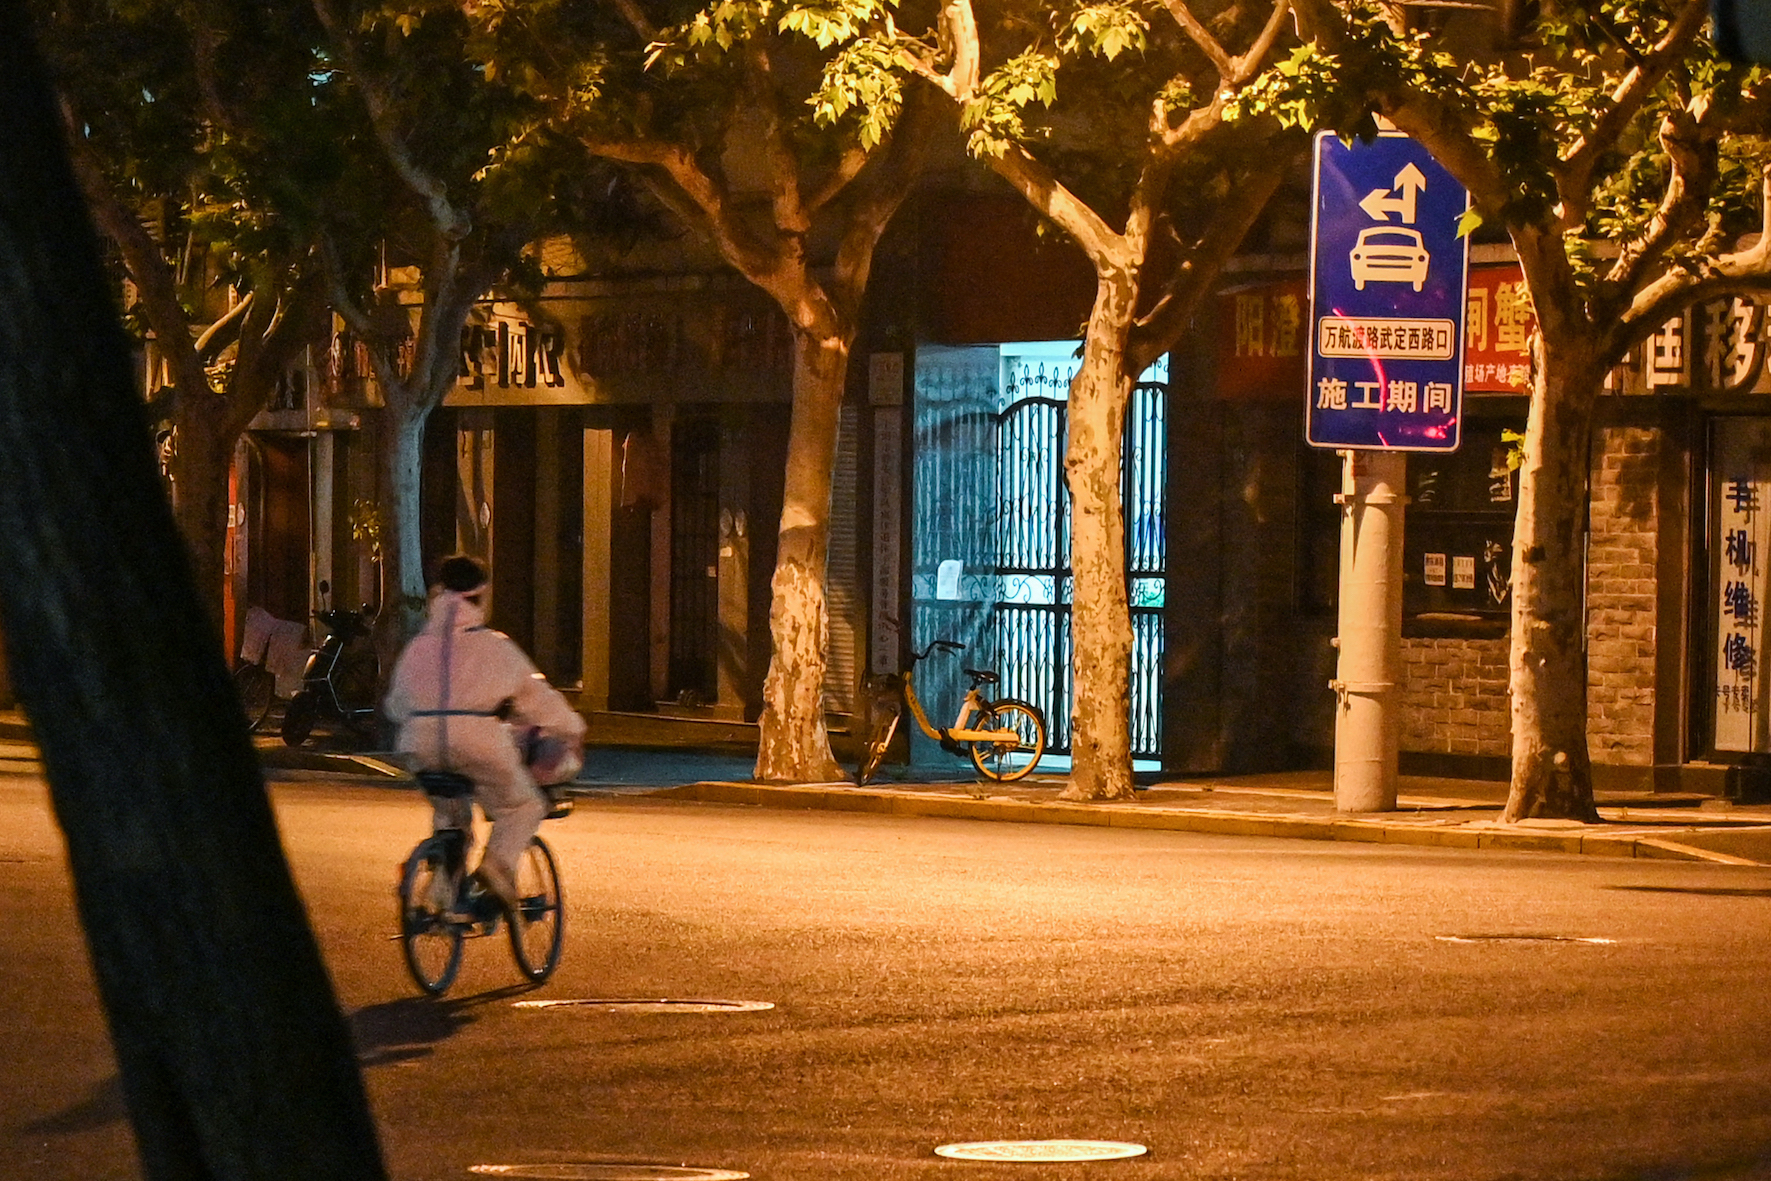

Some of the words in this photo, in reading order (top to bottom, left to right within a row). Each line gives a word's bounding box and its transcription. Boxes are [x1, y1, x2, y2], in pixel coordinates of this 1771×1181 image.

[1324, 325, 1449, 351] 万航渡路武定西路口
[1602, 296, 1771, 393] 国移
[1316, 377, 1453, 414] 施工期间
[1723, 476, 1751, 671] 手机维修
